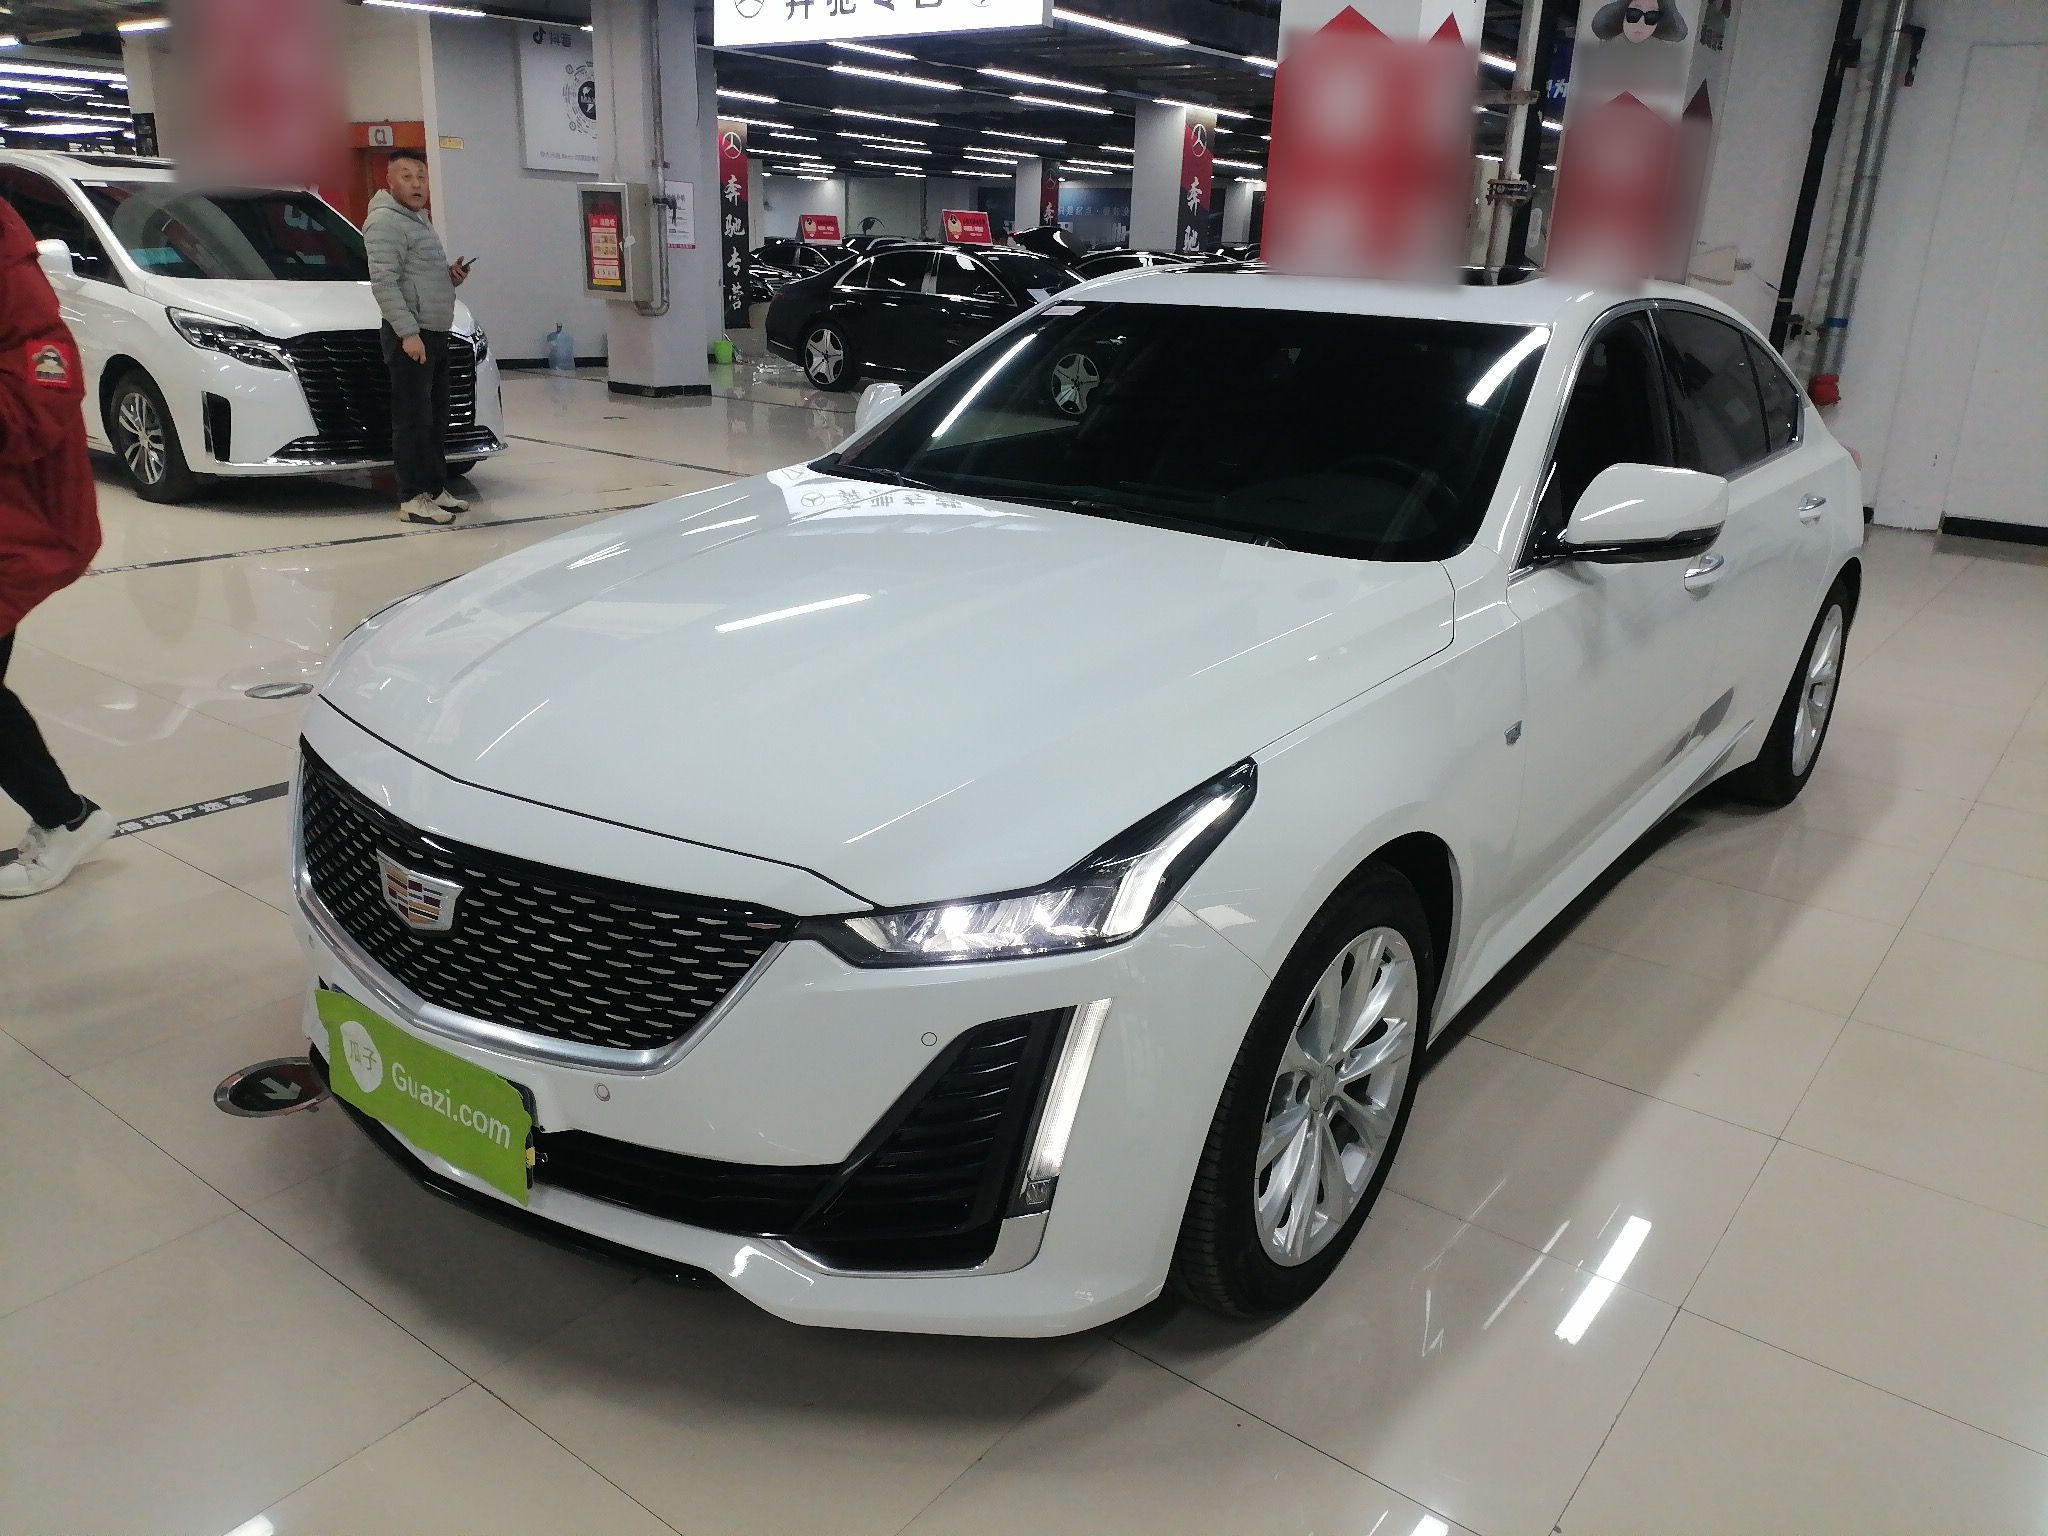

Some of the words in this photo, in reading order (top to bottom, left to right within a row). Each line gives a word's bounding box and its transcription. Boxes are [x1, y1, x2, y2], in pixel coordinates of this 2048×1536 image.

[723, 174, 746, 311] 奔驰专营
[1182, 176, 1202, 252] 奔驰
[349, 1039, 377, 1071] 瓜子
[391, 1062, 511, 1150] Guazi.com
